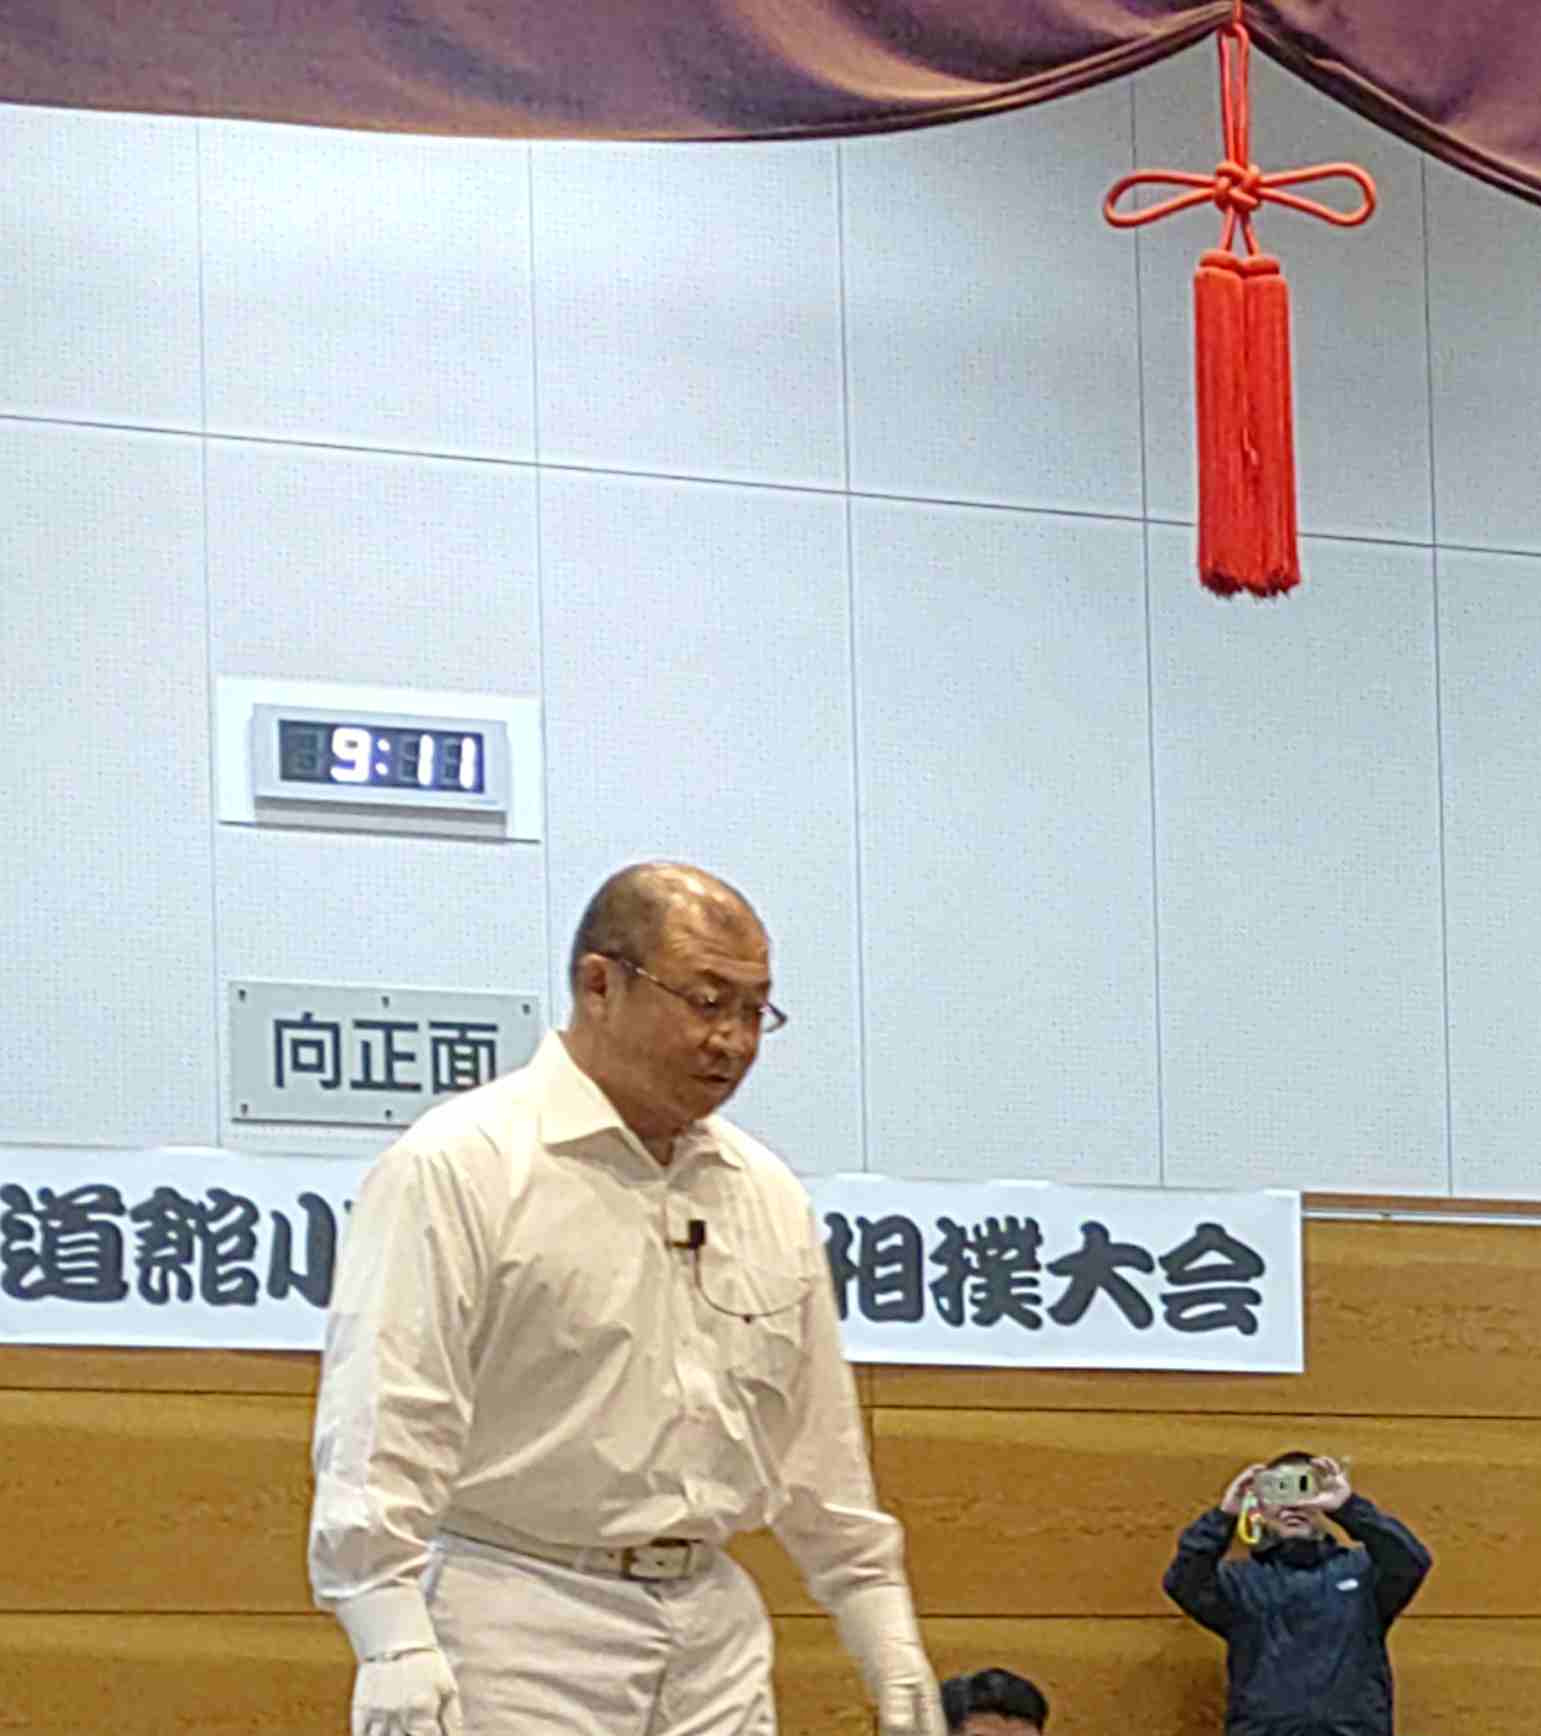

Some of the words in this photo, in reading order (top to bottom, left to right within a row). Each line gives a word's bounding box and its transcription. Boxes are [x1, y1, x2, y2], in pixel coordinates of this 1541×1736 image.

[331, 727, 477, 790] 9:11
[273, 1010, 500, 1095] 向正面
[823, 1212, 1266, 1337] 相撲大会
